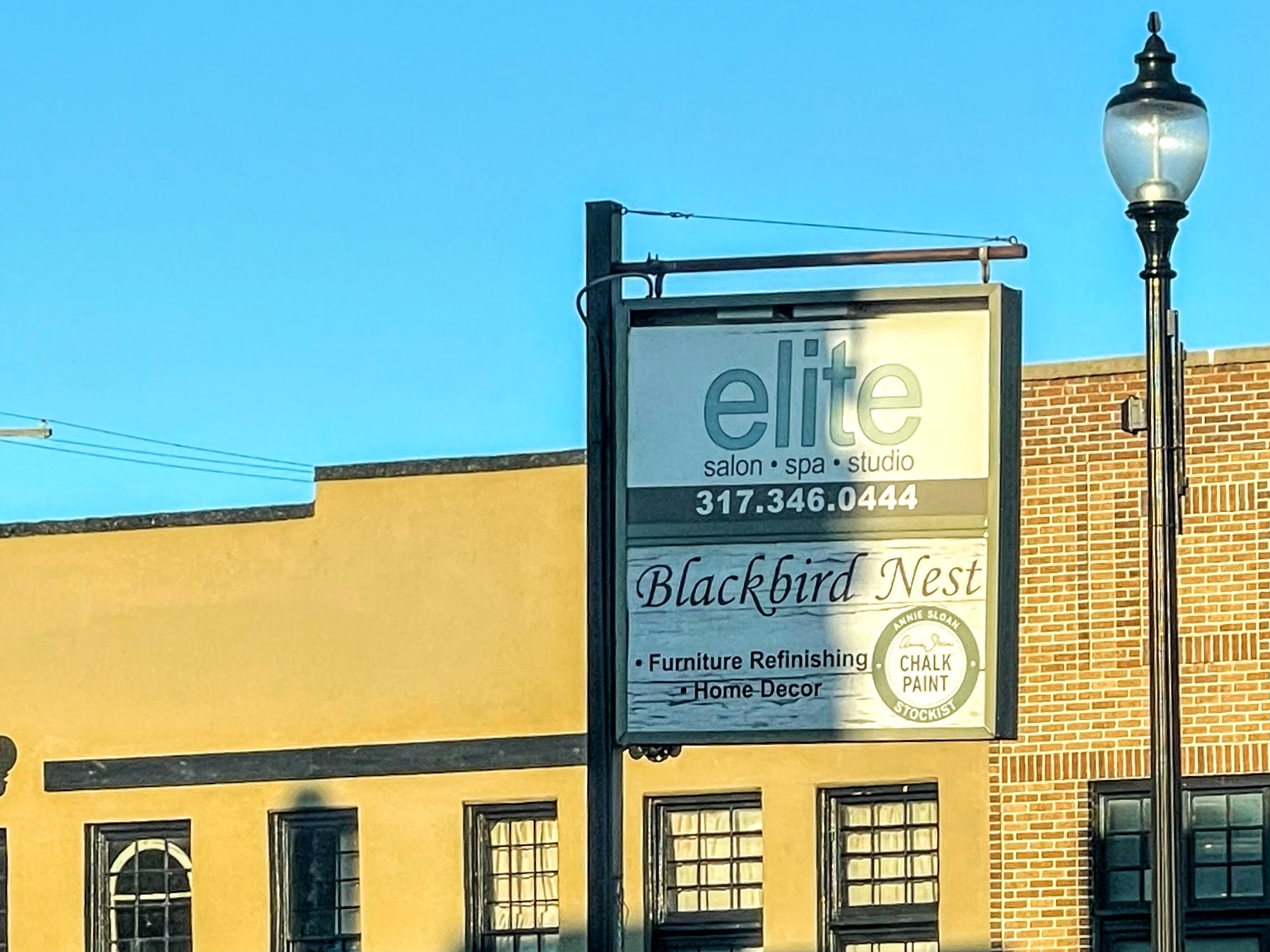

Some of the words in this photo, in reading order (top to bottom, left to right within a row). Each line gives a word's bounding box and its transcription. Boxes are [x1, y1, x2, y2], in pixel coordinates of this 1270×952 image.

[704, 338, 923, 451] elite
[704, 454, 762, 478] salon
[785, 457, 825, 480] spa
[848, 449, 915, 473] studio
[695, 483, 918, 516] 317.346.0444
[636, 553, 868, 617] Blackbird
[875, 555, 983, 601] Nest
[892, 609, 923, 631] ANNIE
[927, 609, 961, 630] SLOAN
[649, 652, 743, 672] Furniture
[750, 649, 868, 672] Refinishing
[900, 653, 952, 672] CHALK
[694, 681, 754, 700] Home
[761, 679, 823, 698] Decor
[902, 675, 949, 693] PAINT
[893, 699, 957, 721] STOCKIST
